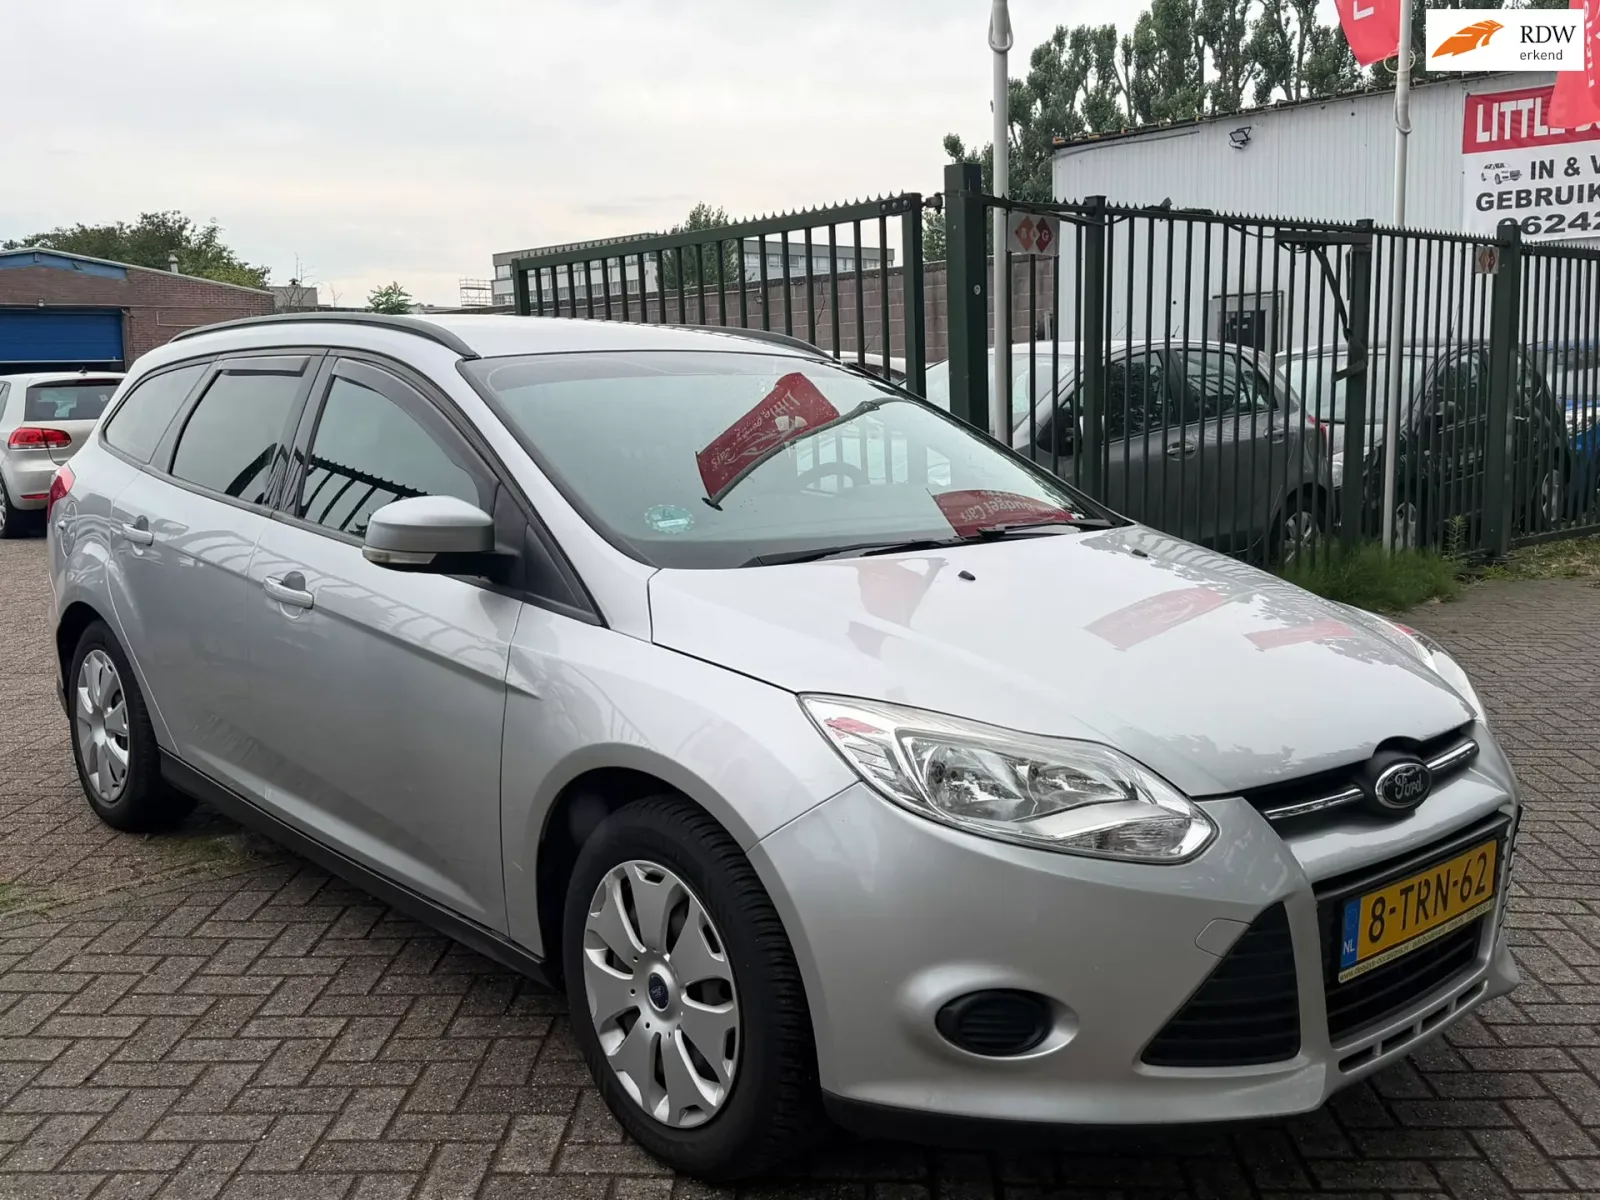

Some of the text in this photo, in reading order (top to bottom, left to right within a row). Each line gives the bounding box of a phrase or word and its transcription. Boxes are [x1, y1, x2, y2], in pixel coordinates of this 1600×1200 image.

[1476, 97, 1566, 143] LITTL
[1530, 159, 1554, 180] IN
[1563, 156, 1580, 177] &
[1395, 768, 1423, 799] Ford
[1368, 852, 1487, 943] 8-TRN-62
[1343, 939, 1355, 955] NL
